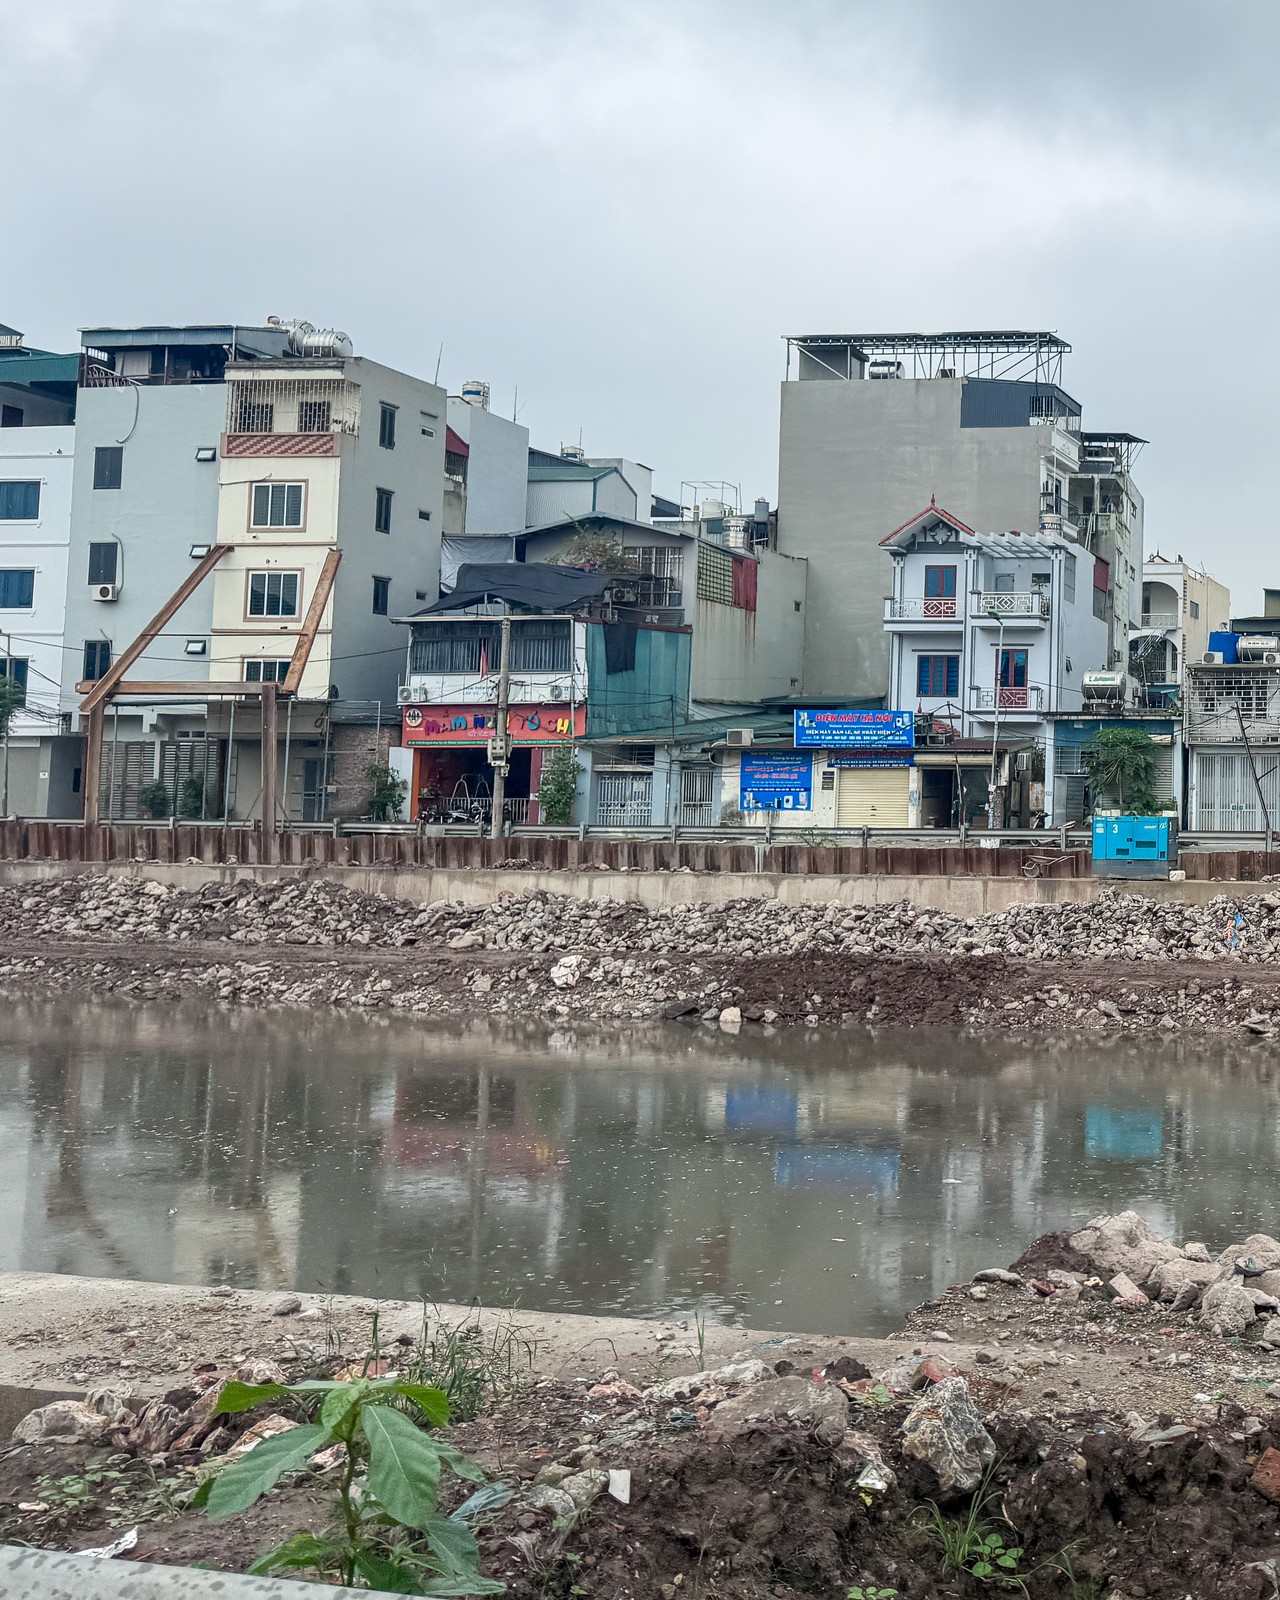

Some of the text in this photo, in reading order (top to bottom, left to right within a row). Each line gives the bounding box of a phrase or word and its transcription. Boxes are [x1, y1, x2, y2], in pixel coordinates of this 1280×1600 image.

[816, 713, 893, 724] ĐIỆN MÁY HÀ NỘI
[1112, 824, 1118, 834] 3
